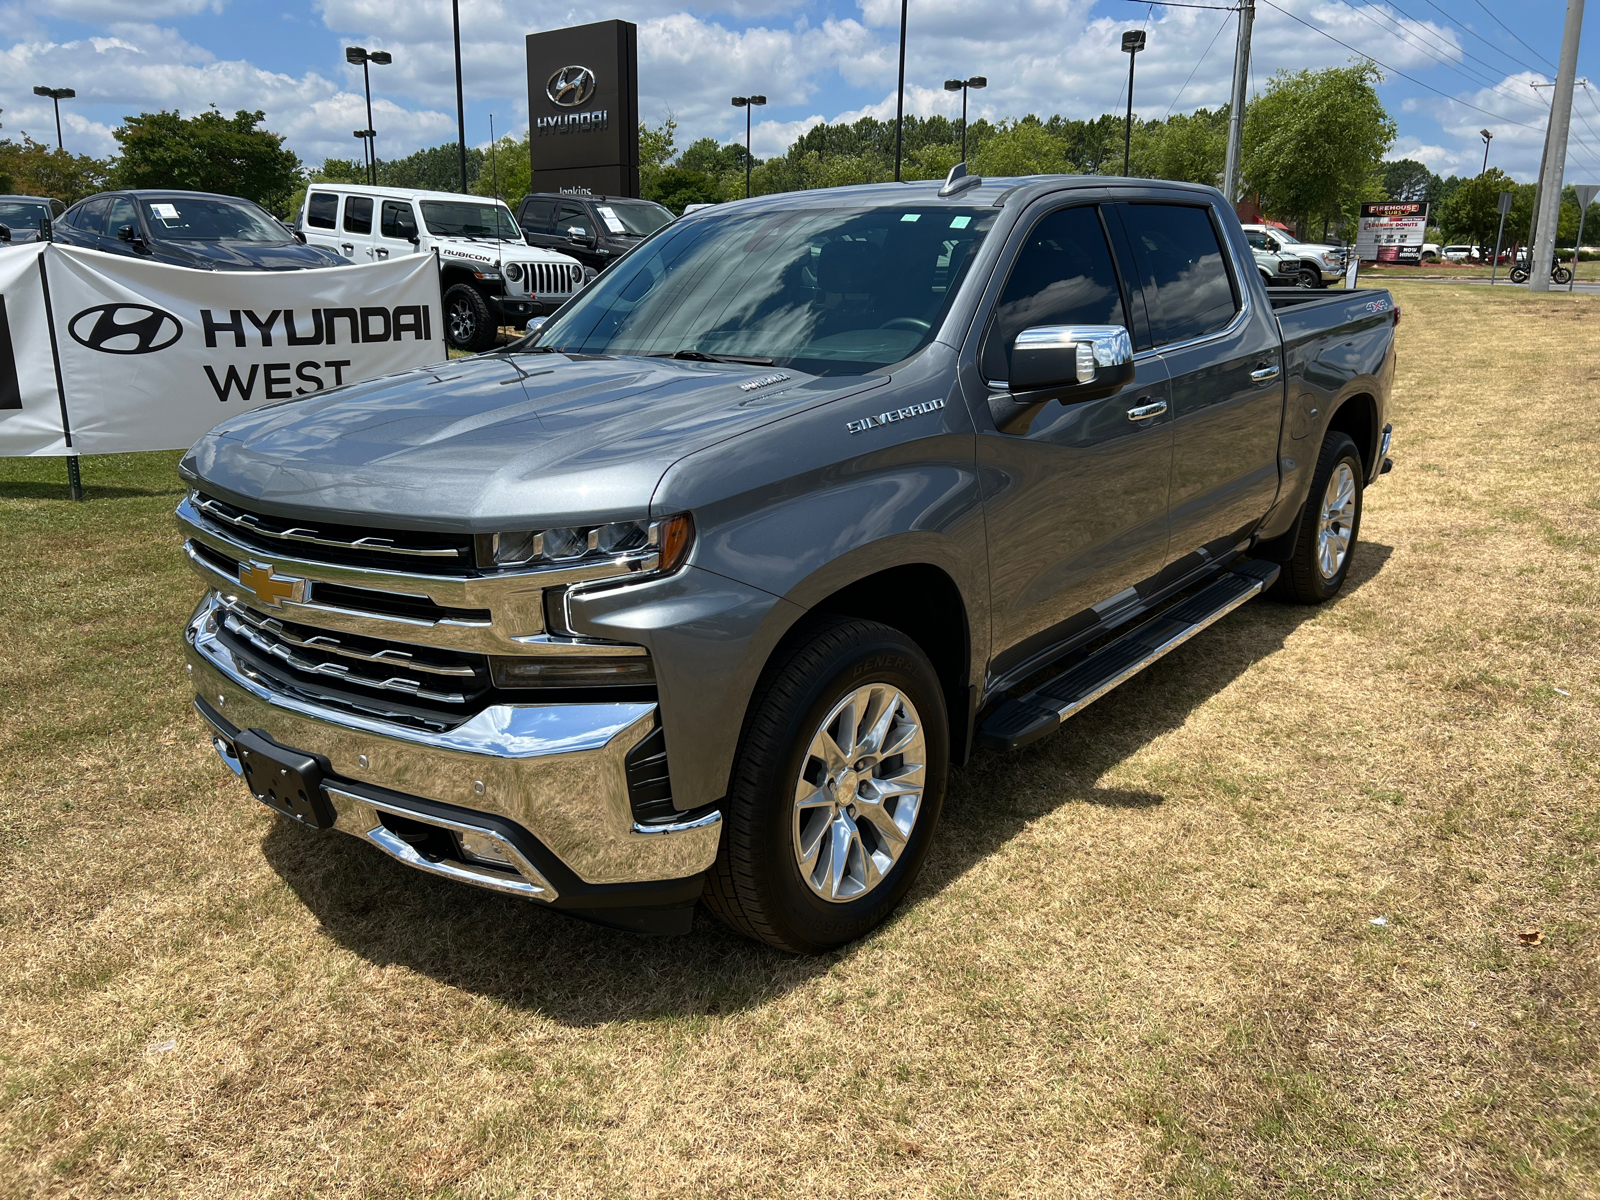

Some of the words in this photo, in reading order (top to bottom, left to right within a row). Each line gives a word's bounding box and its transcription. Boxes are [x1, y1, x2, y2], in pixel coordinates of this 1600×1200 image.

[537, 109, 608, 133] HYUNDAI
[1370, 204, 1418, 213] FIREHOUSE
[443, 249, 491, 262] RUBICON
[200, 305, 431, 348] HYUNDAI
[203, 359, 351, 401] WEST
[846, 398, 946, 434] SILVERADO
[852, 654, 919, 680] GENERAL
